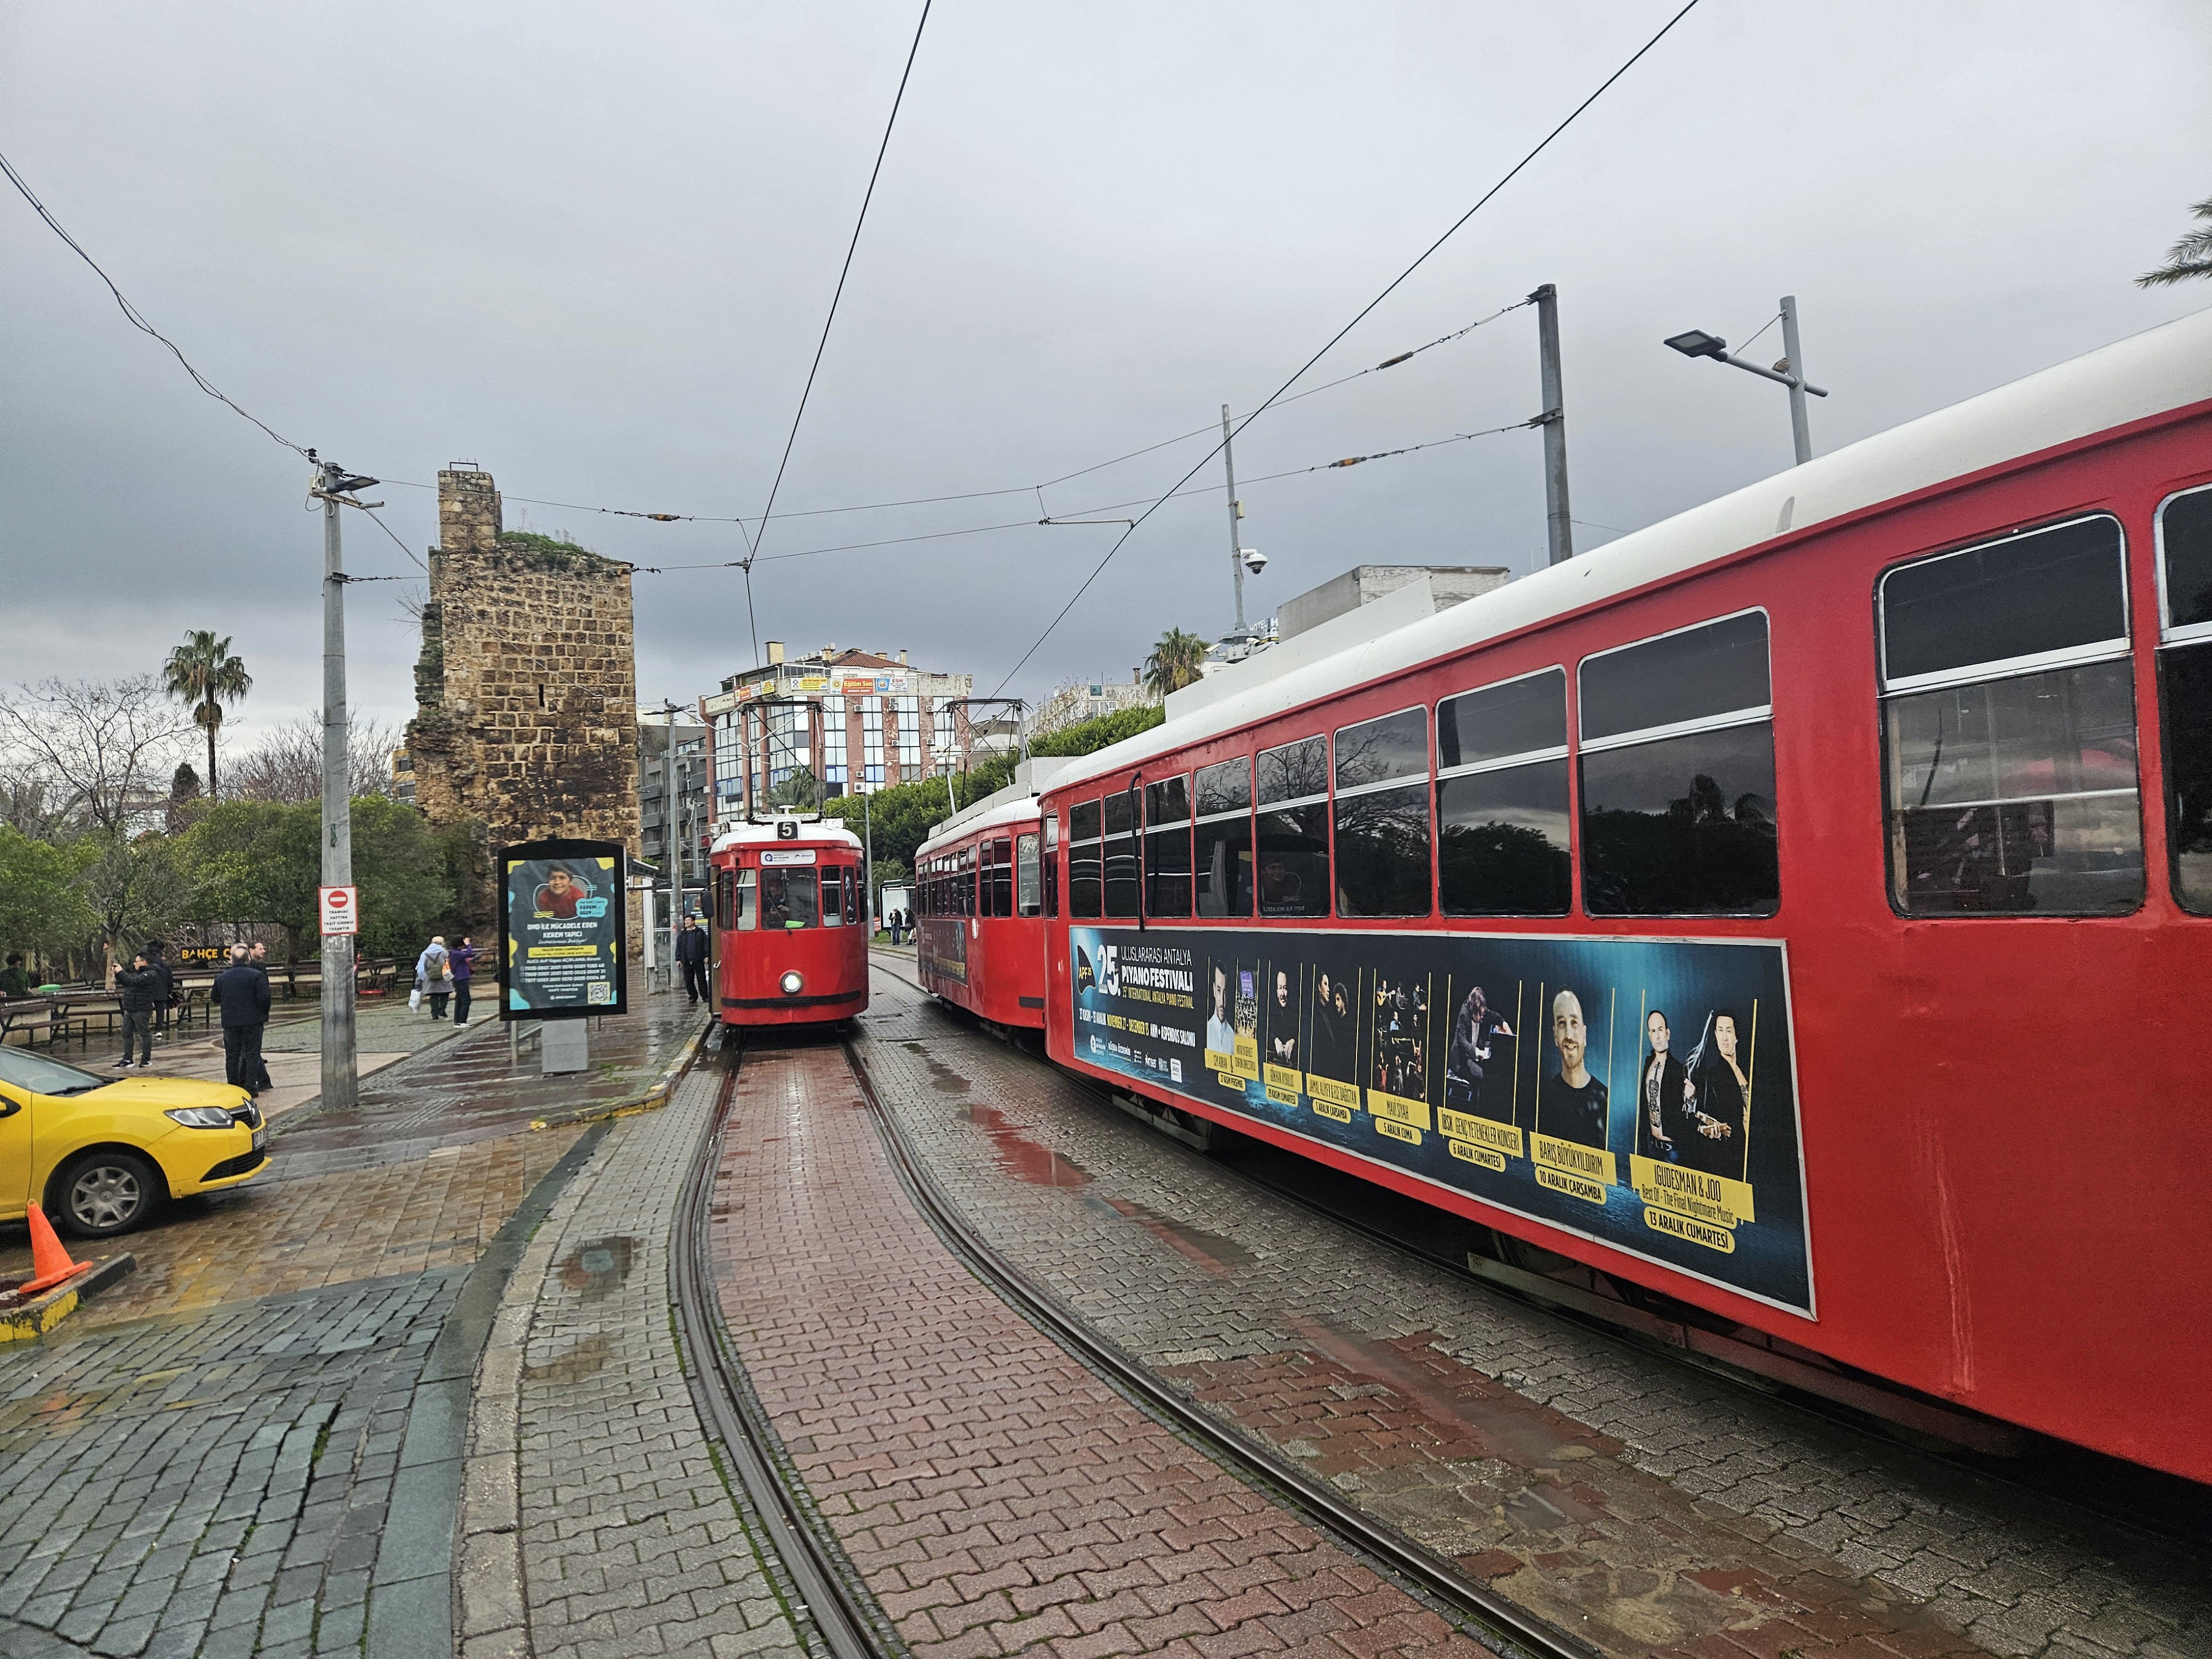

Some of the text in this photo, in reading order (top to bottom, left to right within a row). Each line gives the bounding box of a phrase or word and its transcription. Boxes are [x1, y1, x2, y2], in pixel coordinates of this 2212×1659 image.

[1250, 619, 1267, 630] HOTEL
[781, 822, 792, 836] 5
[541, 921, 550, 930] İLE
[181, 948, 218, 960] BAHÇE
[1121, 946, 1192, 966] ULUSLARARASI ANTALYA
[1079, 967, 1088, 980] APF
[1097, 944, 1121, 997] 25.
[1128, 988, 1152, 1002] INTERNATIONAL
[1152, 991, 1166, 1004] ANTALYA
[1166, 993, 1177, 1006] PIANO
[1177, 994, 1194, 1009] FESTIVAL
[1107, 1014, 1123, 1030] NOVEMBER
[1129, 1019, 1145, 1035] DECEMBER
[1161, 1026, 1180, 1044] ASPENDOS
[1180, 1030, 1196, 1047] SALONU
[1310, 1079, 1321, 1094] JAMAL
[1316, 1102, 1348, 1120] 3 ARALIK ÇARŞAMBA
[1386, 1098, 1408, 1120] MAVİ SİYAH
[1384, 1123, 1413, 1141] 5 ARALIK CUMA
[1455, 1116, 1468, 1139] GENÇ
[1468, 1119, 1497, 1144] YETENEKLER
[1498, 1128, 1519, 1151] KONSERİ
[1453, 1143, 1500, 1168] 6 ARALIK CUMARTESİ
[1540, 1140, 1603, 1176] BARIŞ BÜYÜKYILDIRIM
[1540, 1170, 1602, 1201] 10 ARALIK ÇARŞAMBA
[1654, 1164, 1721, 1202] IGUDESMAN & JOO
[1642, 1183, 1653, 1201] Best
[1653, 1188, 1660, 1202] Of
[1663, 1190, 1673, 1206] The
[1674, 1193, 1687, 1211] Final
[1688, 1197, 1717, 1220] Nightmare
[1717, 1206, 1734, 1224] Music
[1649, 1211, 1729, 1249] 13 ARALIK CUMARTESİ
